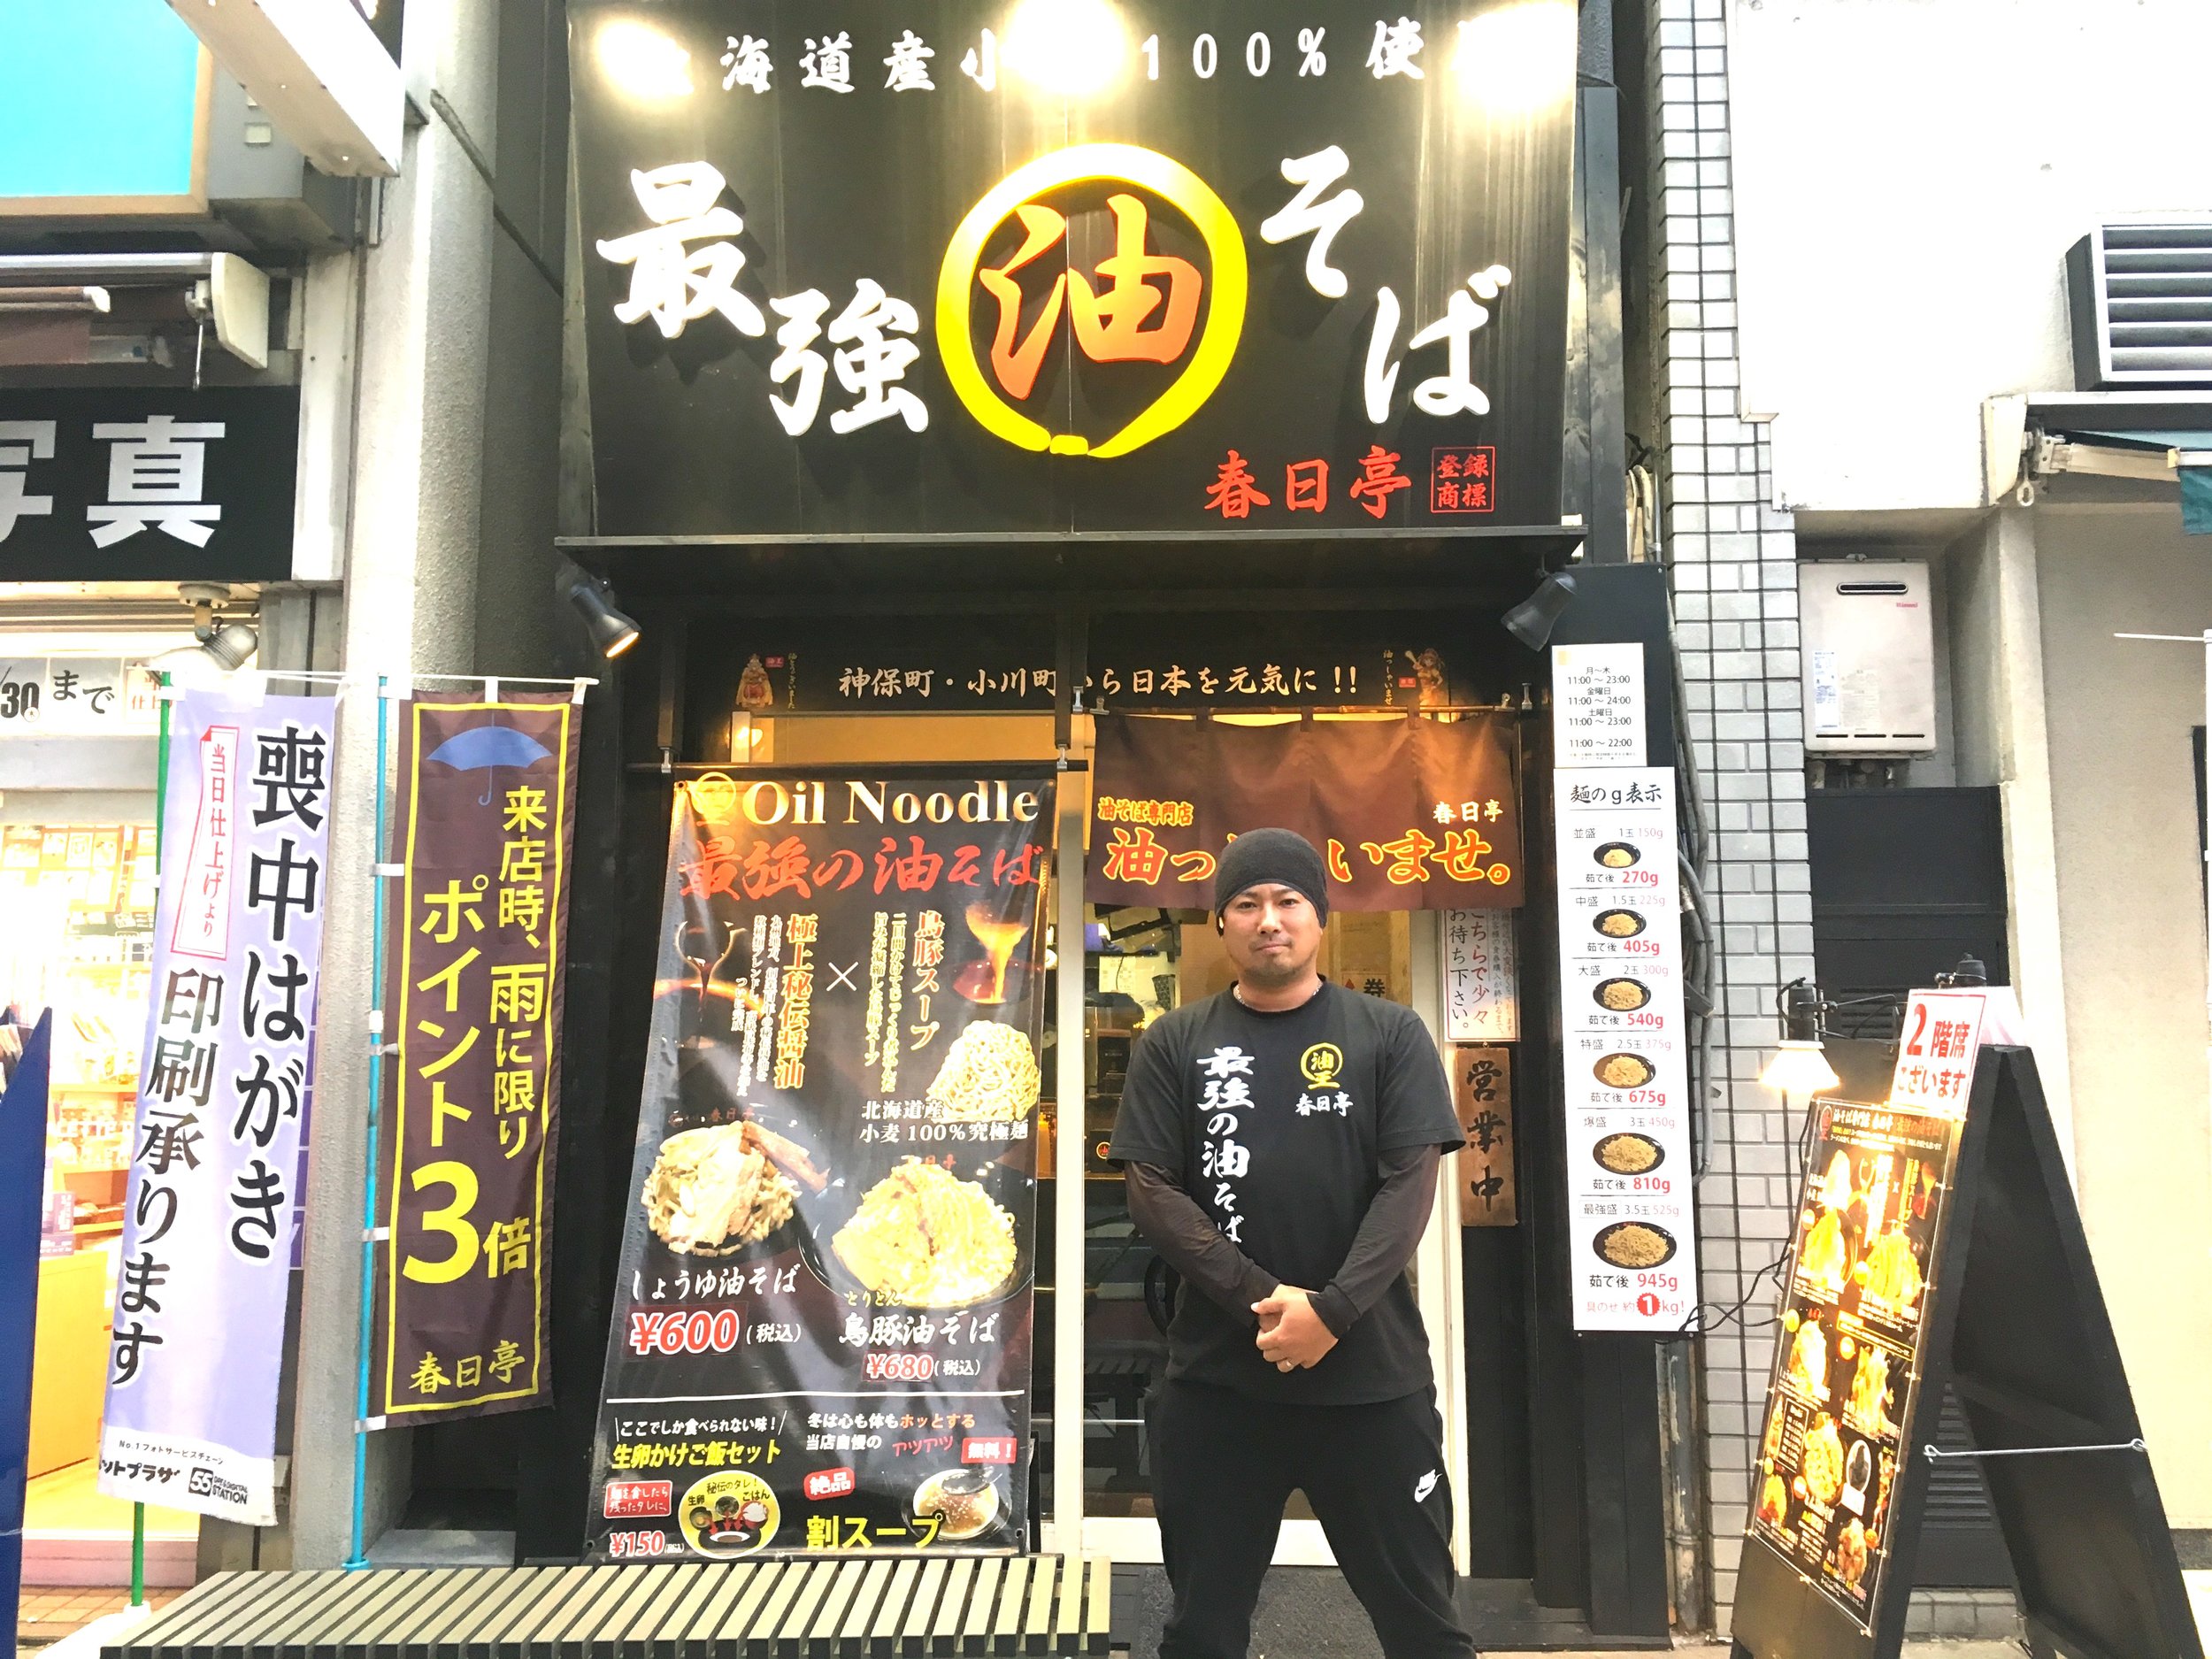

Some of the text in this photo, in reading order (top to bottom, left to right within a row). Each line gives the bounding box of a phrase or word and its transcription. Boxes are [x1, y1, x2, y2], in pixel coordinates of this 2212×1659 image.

[1436, 452, 1490, 479] 登録
[1205, 446, 1411, 518] 春日亭
[1436, 482, 1488, 508] 商標
[53, 670, 115, 714] まで
[1588, 708, 1612, 717] 土曜日
[742, 780, 1039, 825] Oil Noodle
[1097, 795, 1194, 826] 油そば専門店
[1432, 798, 1503, 824] 春日亭
[203, 744, 227, 937] 当日仕上げより
[1573, 828, 1595, 839] 並盛
[678, 835, 1044, 901] 最強の油そば
[1102, 826, 1511, 886] 油っいませ。
[1622, 871, 1659, 887] 270g
[1576, 896, 1598, 907] 中盛
[1624, 940, 1660, 956] 405g
[489, 785, 547, 1159] 来店時、雨に限り
[910, 910, 946, 1051] 鳥豚スープ
[1449, 909, 1469, 1029] お待ち下さい。
[1578, 965, 1601, 976] 大盛
[232, 726, 326, 1259] 喪中はがき
[774, 913, 818, 1089] 極上秘伝醤油
[1627, 1013, 1663, 1028] 540g
[1907, 1002, 1970, 1059] 2階席
[1580, 1039, 1603, 1049] 特盛
[1898, 1064, 1967, 1099] ございます
[861, 1099, 945, 1120] 北海道産
[1295, 1091, 1354, 1117] 春日亭
[1629, 1090, 1666, 1106] 675g
[1196, 1046, 1255, 1243] 最強の油そば
[1466, 1060, 1506, 1212] 営業中
[111, 968, 225, 1385] 印刷承ります
[1633, 1177, 1671, 1194] 810g
[1584, 1203, 1617, 1216] 最強盛
[632, 1263, 802, 1301] しょうゆ油そば
[1637, 1272, 1678, 1292] 945g
[843, 1290, 902, 1308] とりとん
[630, 1309, 802, 1356] ¥600 (税込)
[839, 1310, 1000, 1348] 鳥豚油そば
[409, 1340, 525, 1394] 春日亭
[865, 1354, 981, 1380] ¥680 (税込)
[807, 1413, 976, 1429] 冬は心も体もホッとする
[611, 1439, 781, 1470] 生卵かけご飯セット
[806, 1434, 955, 1457] 当店自慢の アツアツ
[212, 1485, 248, 1505] STATION
[742, 1491, 771, 1502] ごはん
[810, 1471, 851, 1495] 絶品
[687, 1495, 706, 1506] 生卵
[609, 1530, 665, 1557] ¥150
[806, 1511, 945, 1552] 割スープ
